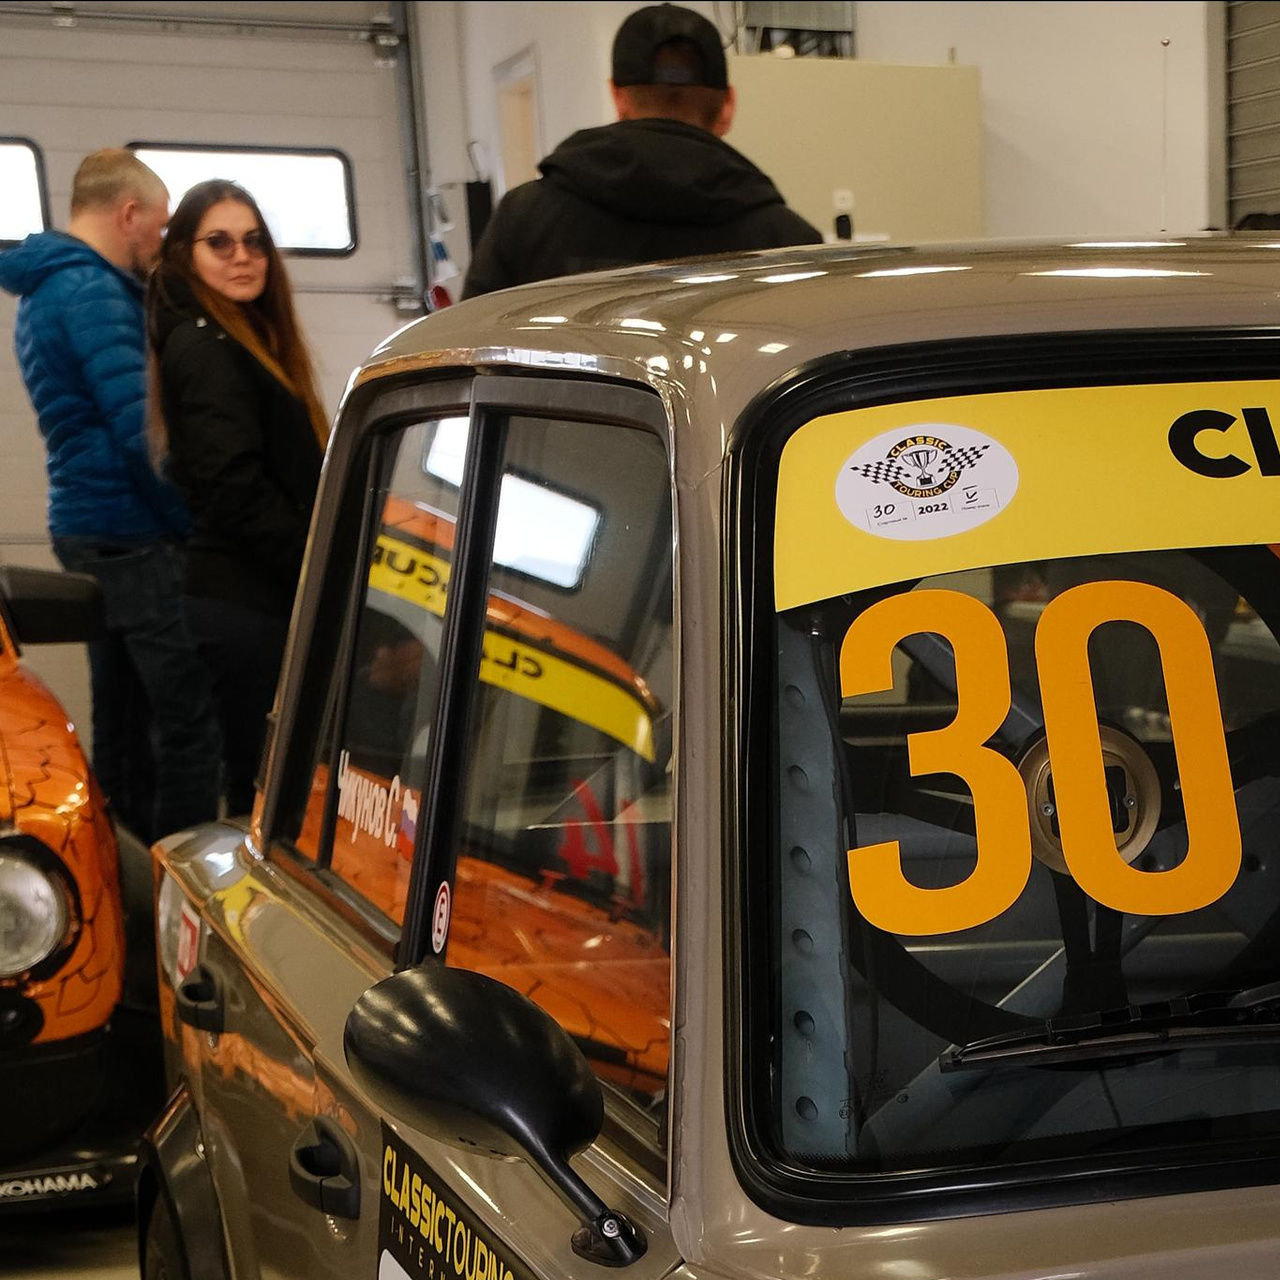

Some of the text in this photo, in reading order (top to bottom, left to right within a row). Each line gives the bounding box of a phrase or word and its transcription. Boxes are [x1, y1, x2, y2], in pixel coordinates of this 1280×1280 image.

[890, 436, 947, 457] CLASSIC
[894, 471, 958, 498] TOURING CUP
[873, 503, 896, 519] 30
[918, 503, 949, 515] 2022
[838, 578, 1243, 936] 30
